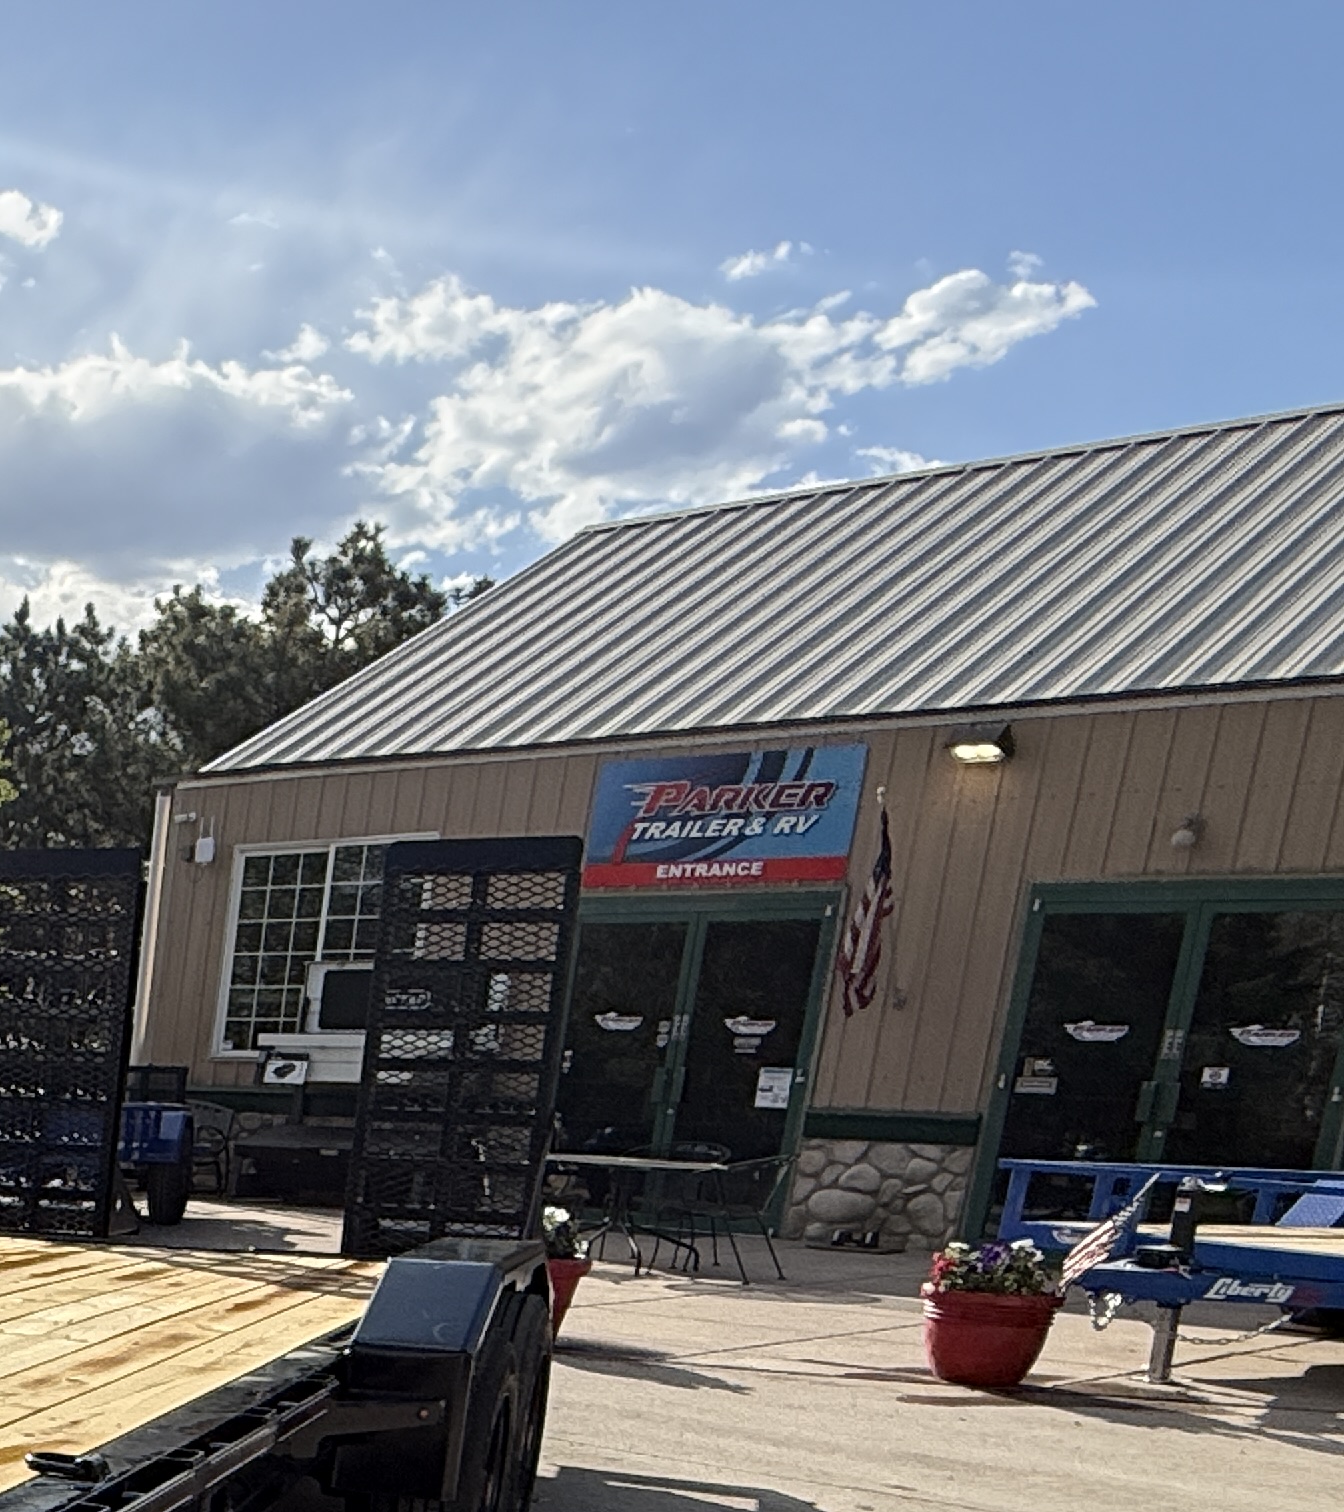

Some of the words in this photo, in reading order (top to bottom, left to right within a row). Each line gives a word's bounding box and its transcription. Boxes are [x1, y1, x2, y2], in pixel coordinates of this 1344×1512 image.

[640, 780, 838, 817] PARKER
[631, 818, 744, 839] TRAILER
[773, 814, 820, 835] RV
[656, 861, 764, 879] ENTRANCE
[1202, 1277, 1296, 1304] Liberty
